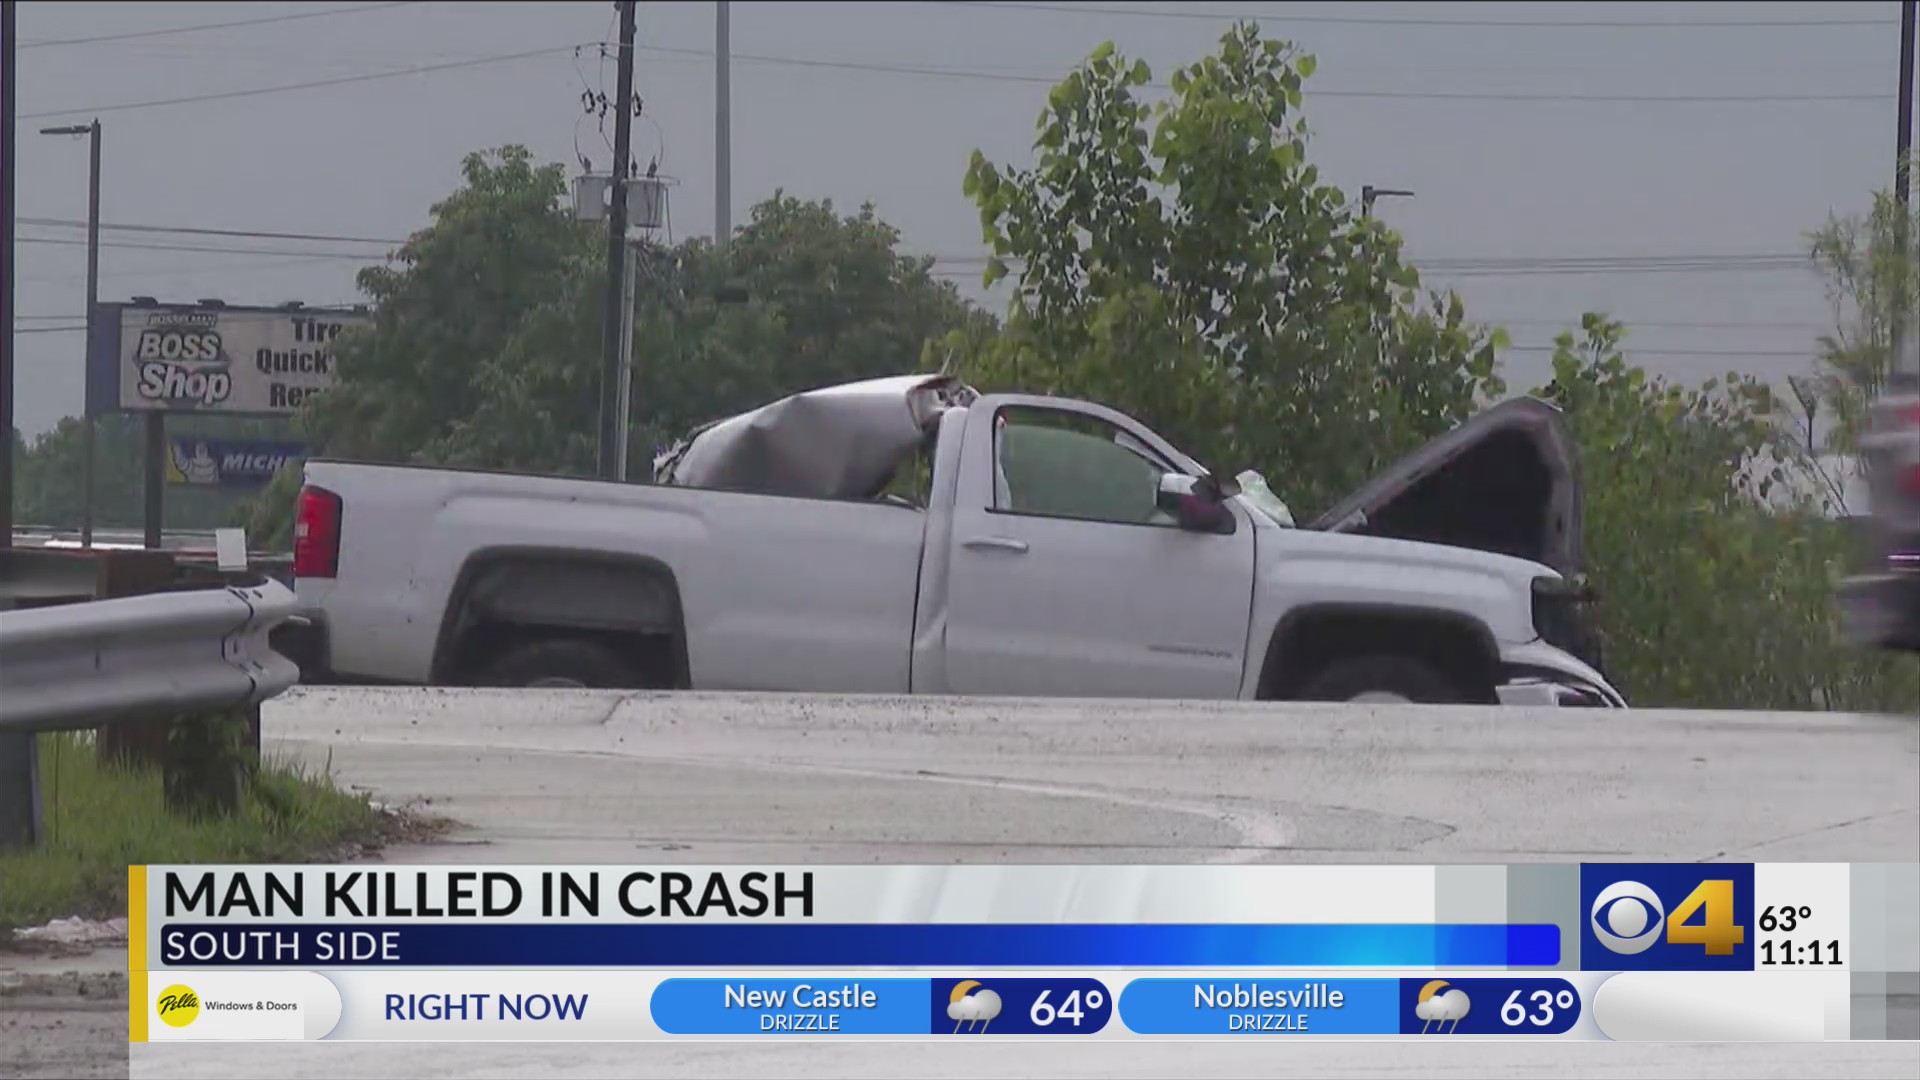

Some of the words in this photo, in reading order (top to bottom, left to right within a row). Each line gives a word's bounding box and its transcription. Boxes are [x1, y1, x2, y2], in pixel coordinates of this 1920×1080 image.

[291, 317, 342, 342] Tire
[139, 332, 220, 360] BOSS
[140, 364, 231, 404] Shop
[222, 454, 288, 471] MICH
